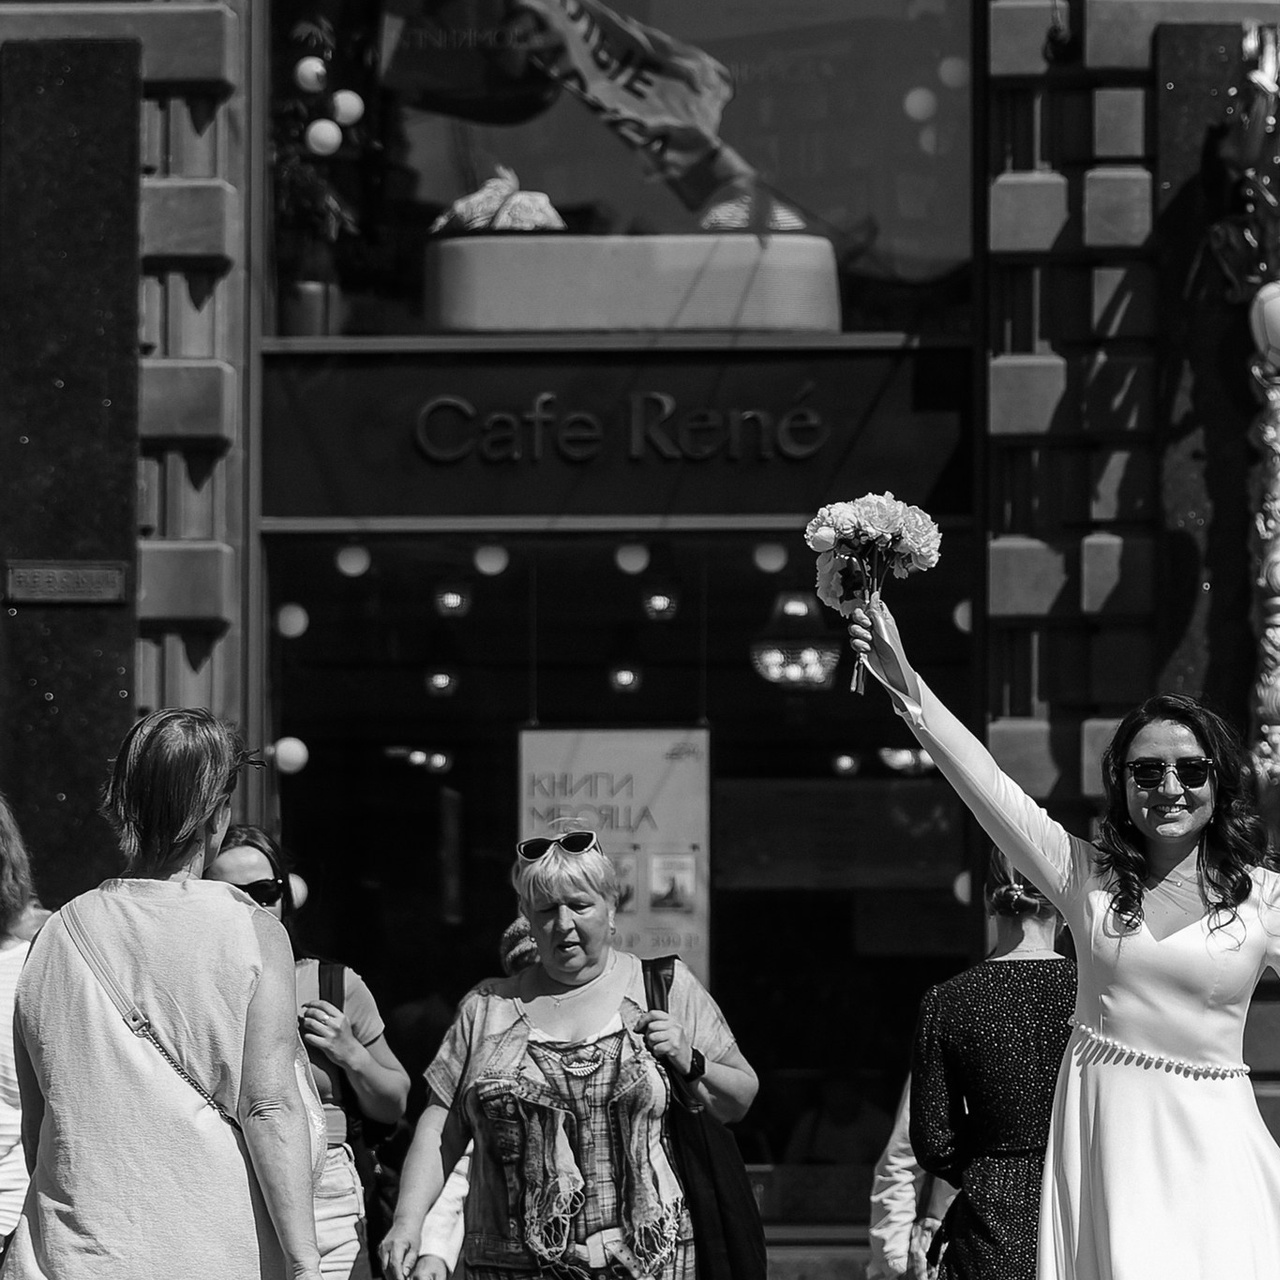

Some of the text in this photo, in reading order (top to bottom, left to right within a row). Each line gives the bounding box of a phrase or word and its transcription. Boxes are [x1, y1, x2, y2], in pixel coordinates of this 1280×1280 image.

[415, 380, 832, 462] Cafe René
[528, 771, 635, 799] КНИГИ
